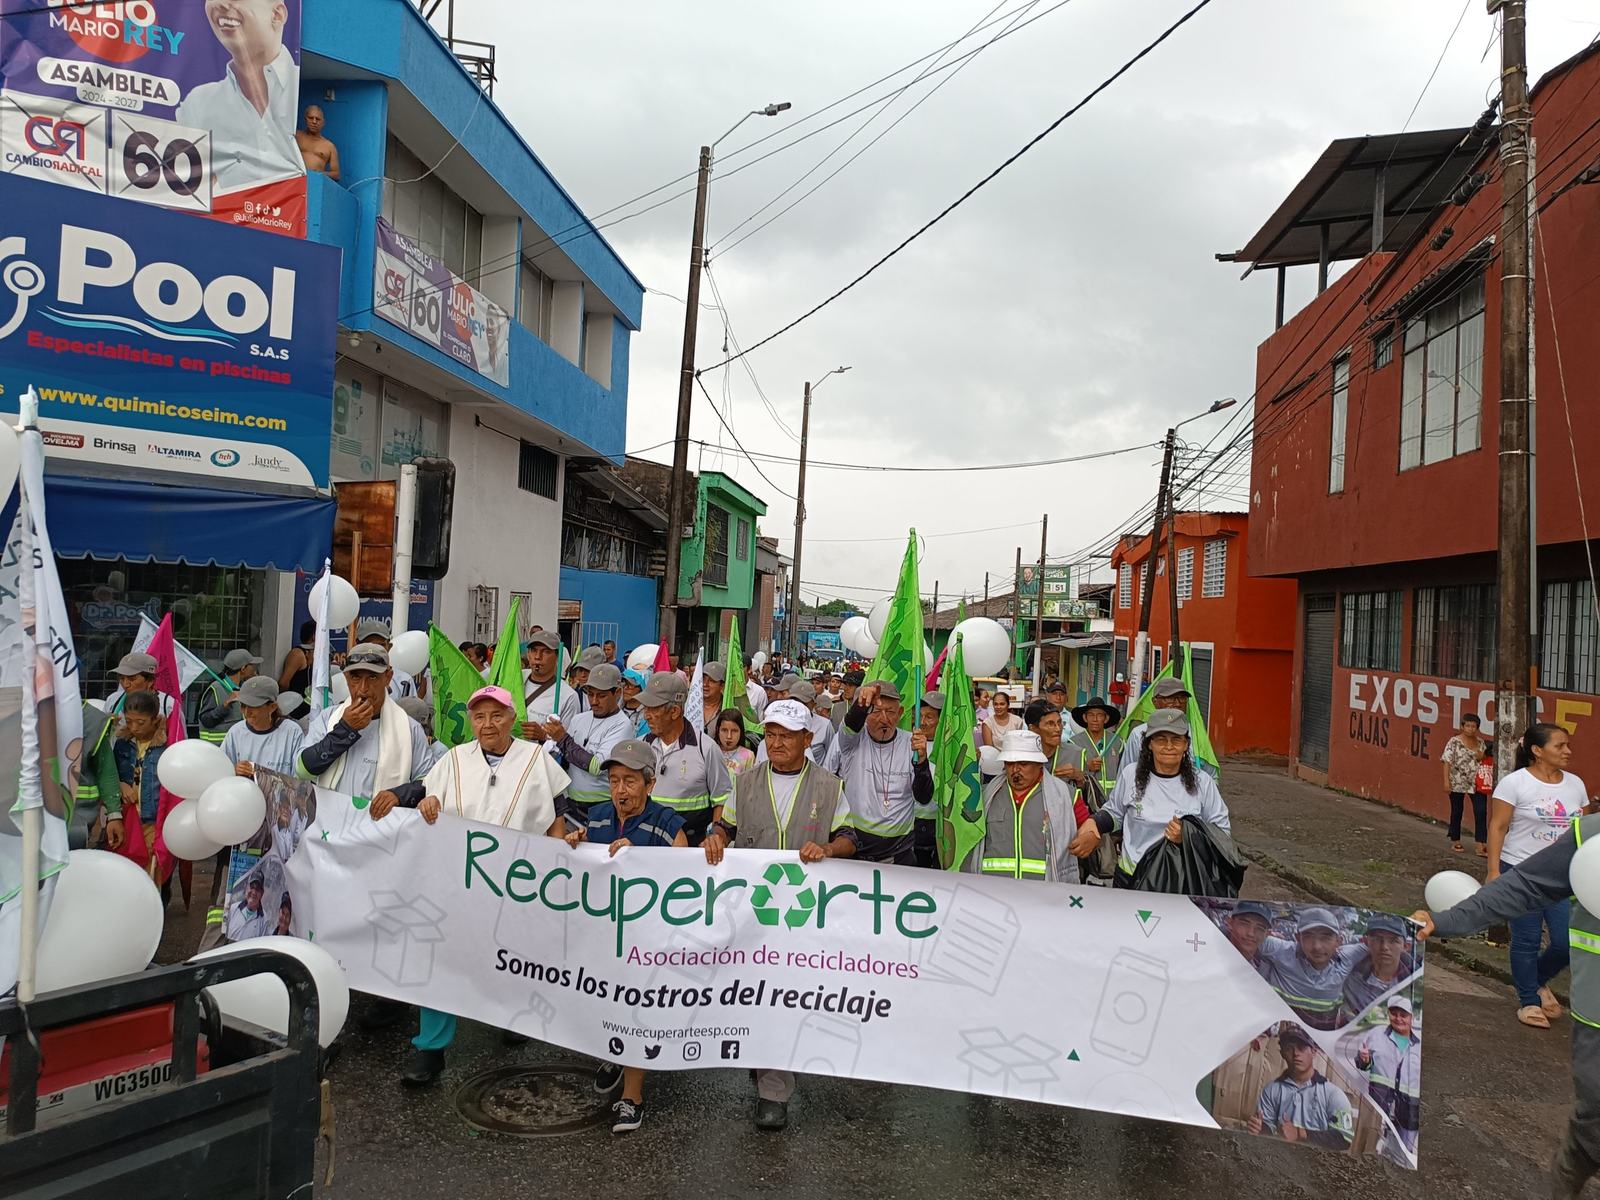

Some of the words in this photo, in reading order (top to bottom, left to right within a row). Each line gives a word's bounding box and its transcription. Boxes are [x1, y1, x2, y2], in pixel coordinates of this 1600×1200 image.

[49, 12, 119, 39] MARIO
[123, 18, 184, 55] REY
[51, 63, 168, 101] ASAMBLEA
[82, 90, 107, 104] 2024
[114, 97, 138, 109] 2027
[123, 131, 203, 196] 60
[233, 212, 293, 230] @JulioMarioRey
[395, 233, 433, 272] ASAMBLEA
[58, 224, 296, 340] Pool
[414, 287, 441, 334] 60
[446, 307, 467, 329] MARIO
[447, 285, 477, 321] JULIO
[27, 331, 174, 368] Especialistas
[180, 356, 205, 372] en
[210, 361, 291, 385] piscinas
[250, 344, 289, 361] S.A.S
[39, 386, 287, 431] www.quimicoseim.com
[43, 437, 79, 447] OVELMA
[93, 437, 136, 453] Brinsa
[147, 443, 202, 459] ALTAMIRA
[253, 454, 281, 467] Jandy
[87, 604, 112, 618] Dr.
[1350, 711, 1389, 748] CAJAS
[1411, 725, 1430, 760] DE
[627, 945, 745, 967] Asociación
[752, 944, 780, 965] de
[786, 948, 919, 979] recicladores
[495, 948, 571, 986] Somos
[575, 966, 608, 999] los
[613, 982, 713, 1008] rostros
[719, 979, 765, 1007] del
[769, 985, 892, 1023] reciclaje
[602, 1020, 750, 1040] www.recuperarteesp.com
[94, 1063, 172, 1102] WG3500
